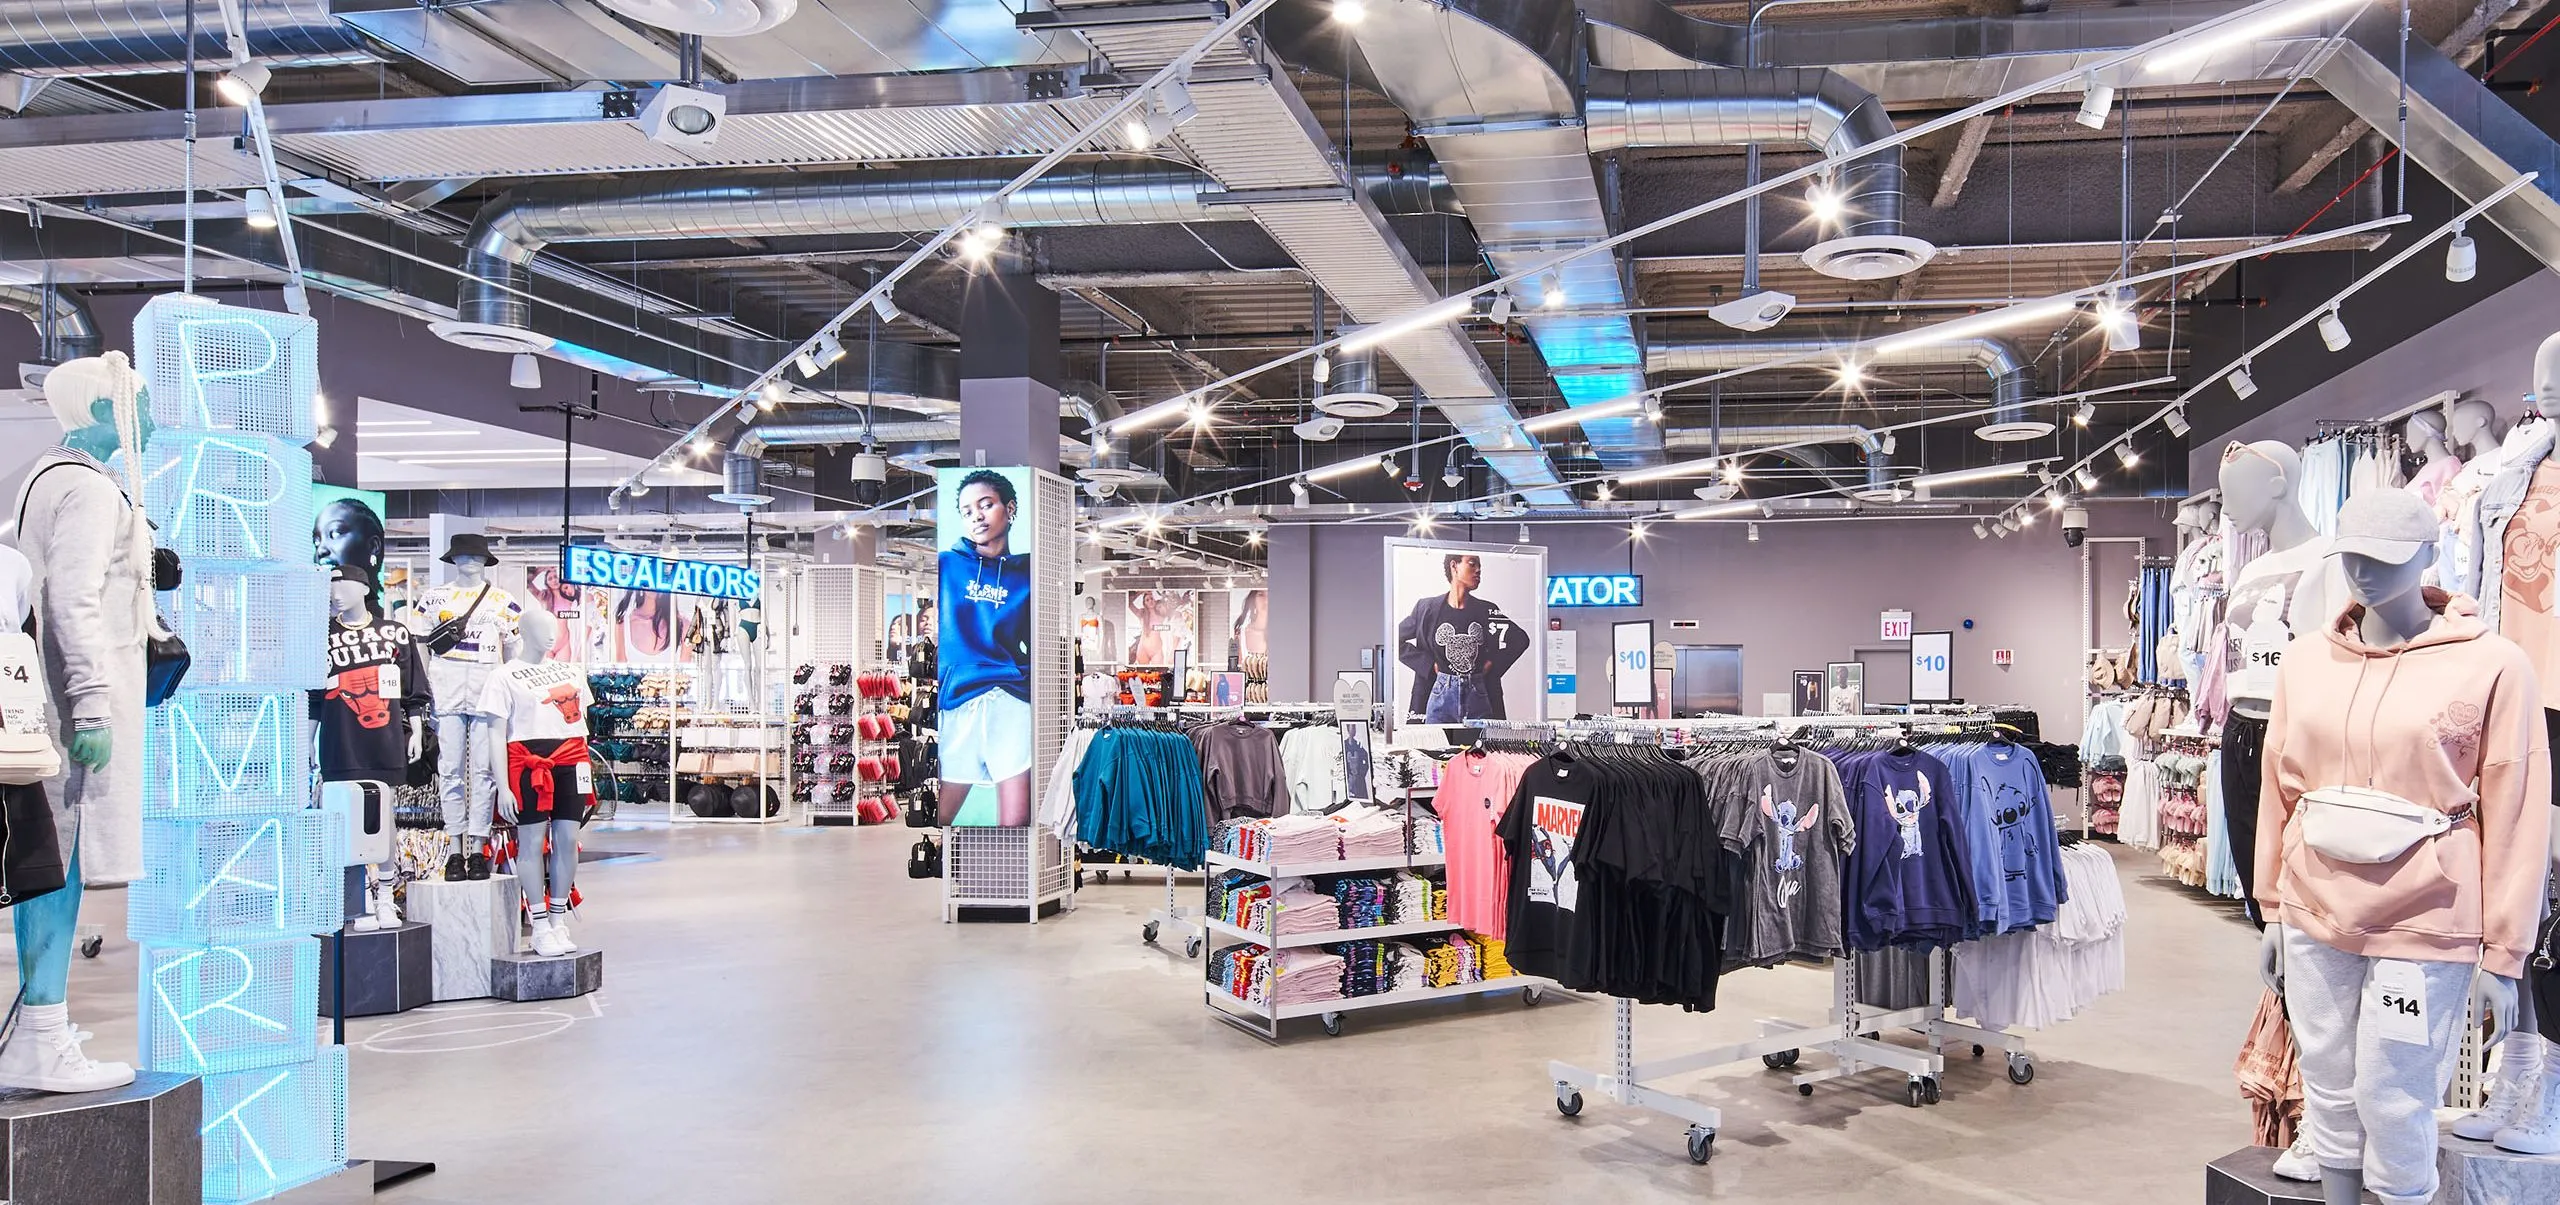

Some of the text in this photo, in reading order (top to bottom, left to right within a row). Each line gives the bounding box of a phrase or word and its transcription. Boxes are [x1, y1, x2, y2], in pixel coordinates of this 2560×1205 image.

[570, 547, 760, 599] ESCALATORS
[559, 611, 579, 619] SWIM
[329, 625, 409, 648] ICAGO
[1488, 622, 1509, 643] $7
[1884, 621, 1909, 637] EXIT
[1619, 650, 1646, 670] $10
[1916, 655, 1945, 672] $10
[2252, 651, 2281, 666] $16
[3, 665, 29, 684] $4
[2382, 995, 2420, 1017] $14
